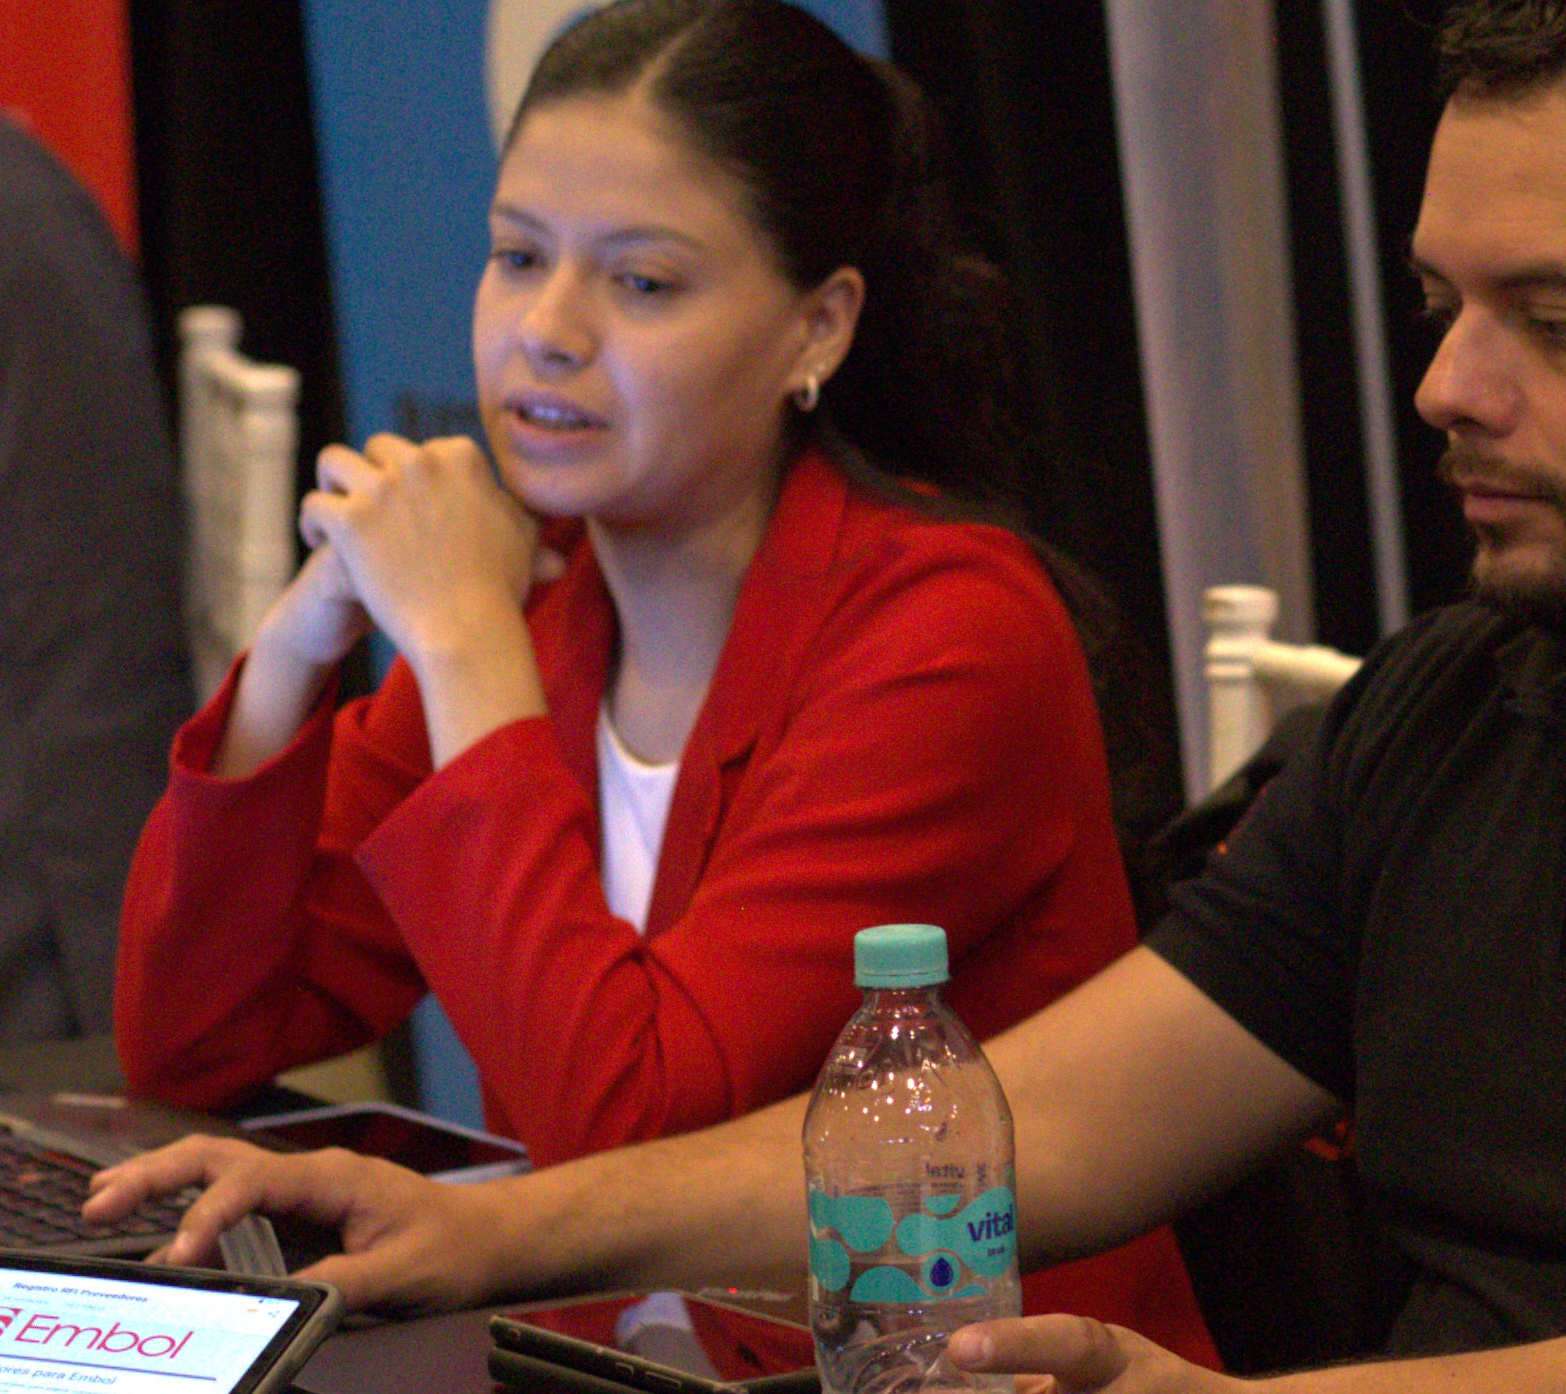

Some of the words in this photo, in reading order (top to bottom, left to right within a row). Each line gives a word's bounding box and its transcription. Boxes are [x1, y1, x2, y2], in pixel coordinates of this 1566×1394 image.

[14, 1314, 194, 1359] Embol
[32, 1369, 66, 1380] para
[69, 1371, 118, 1386] Embol
